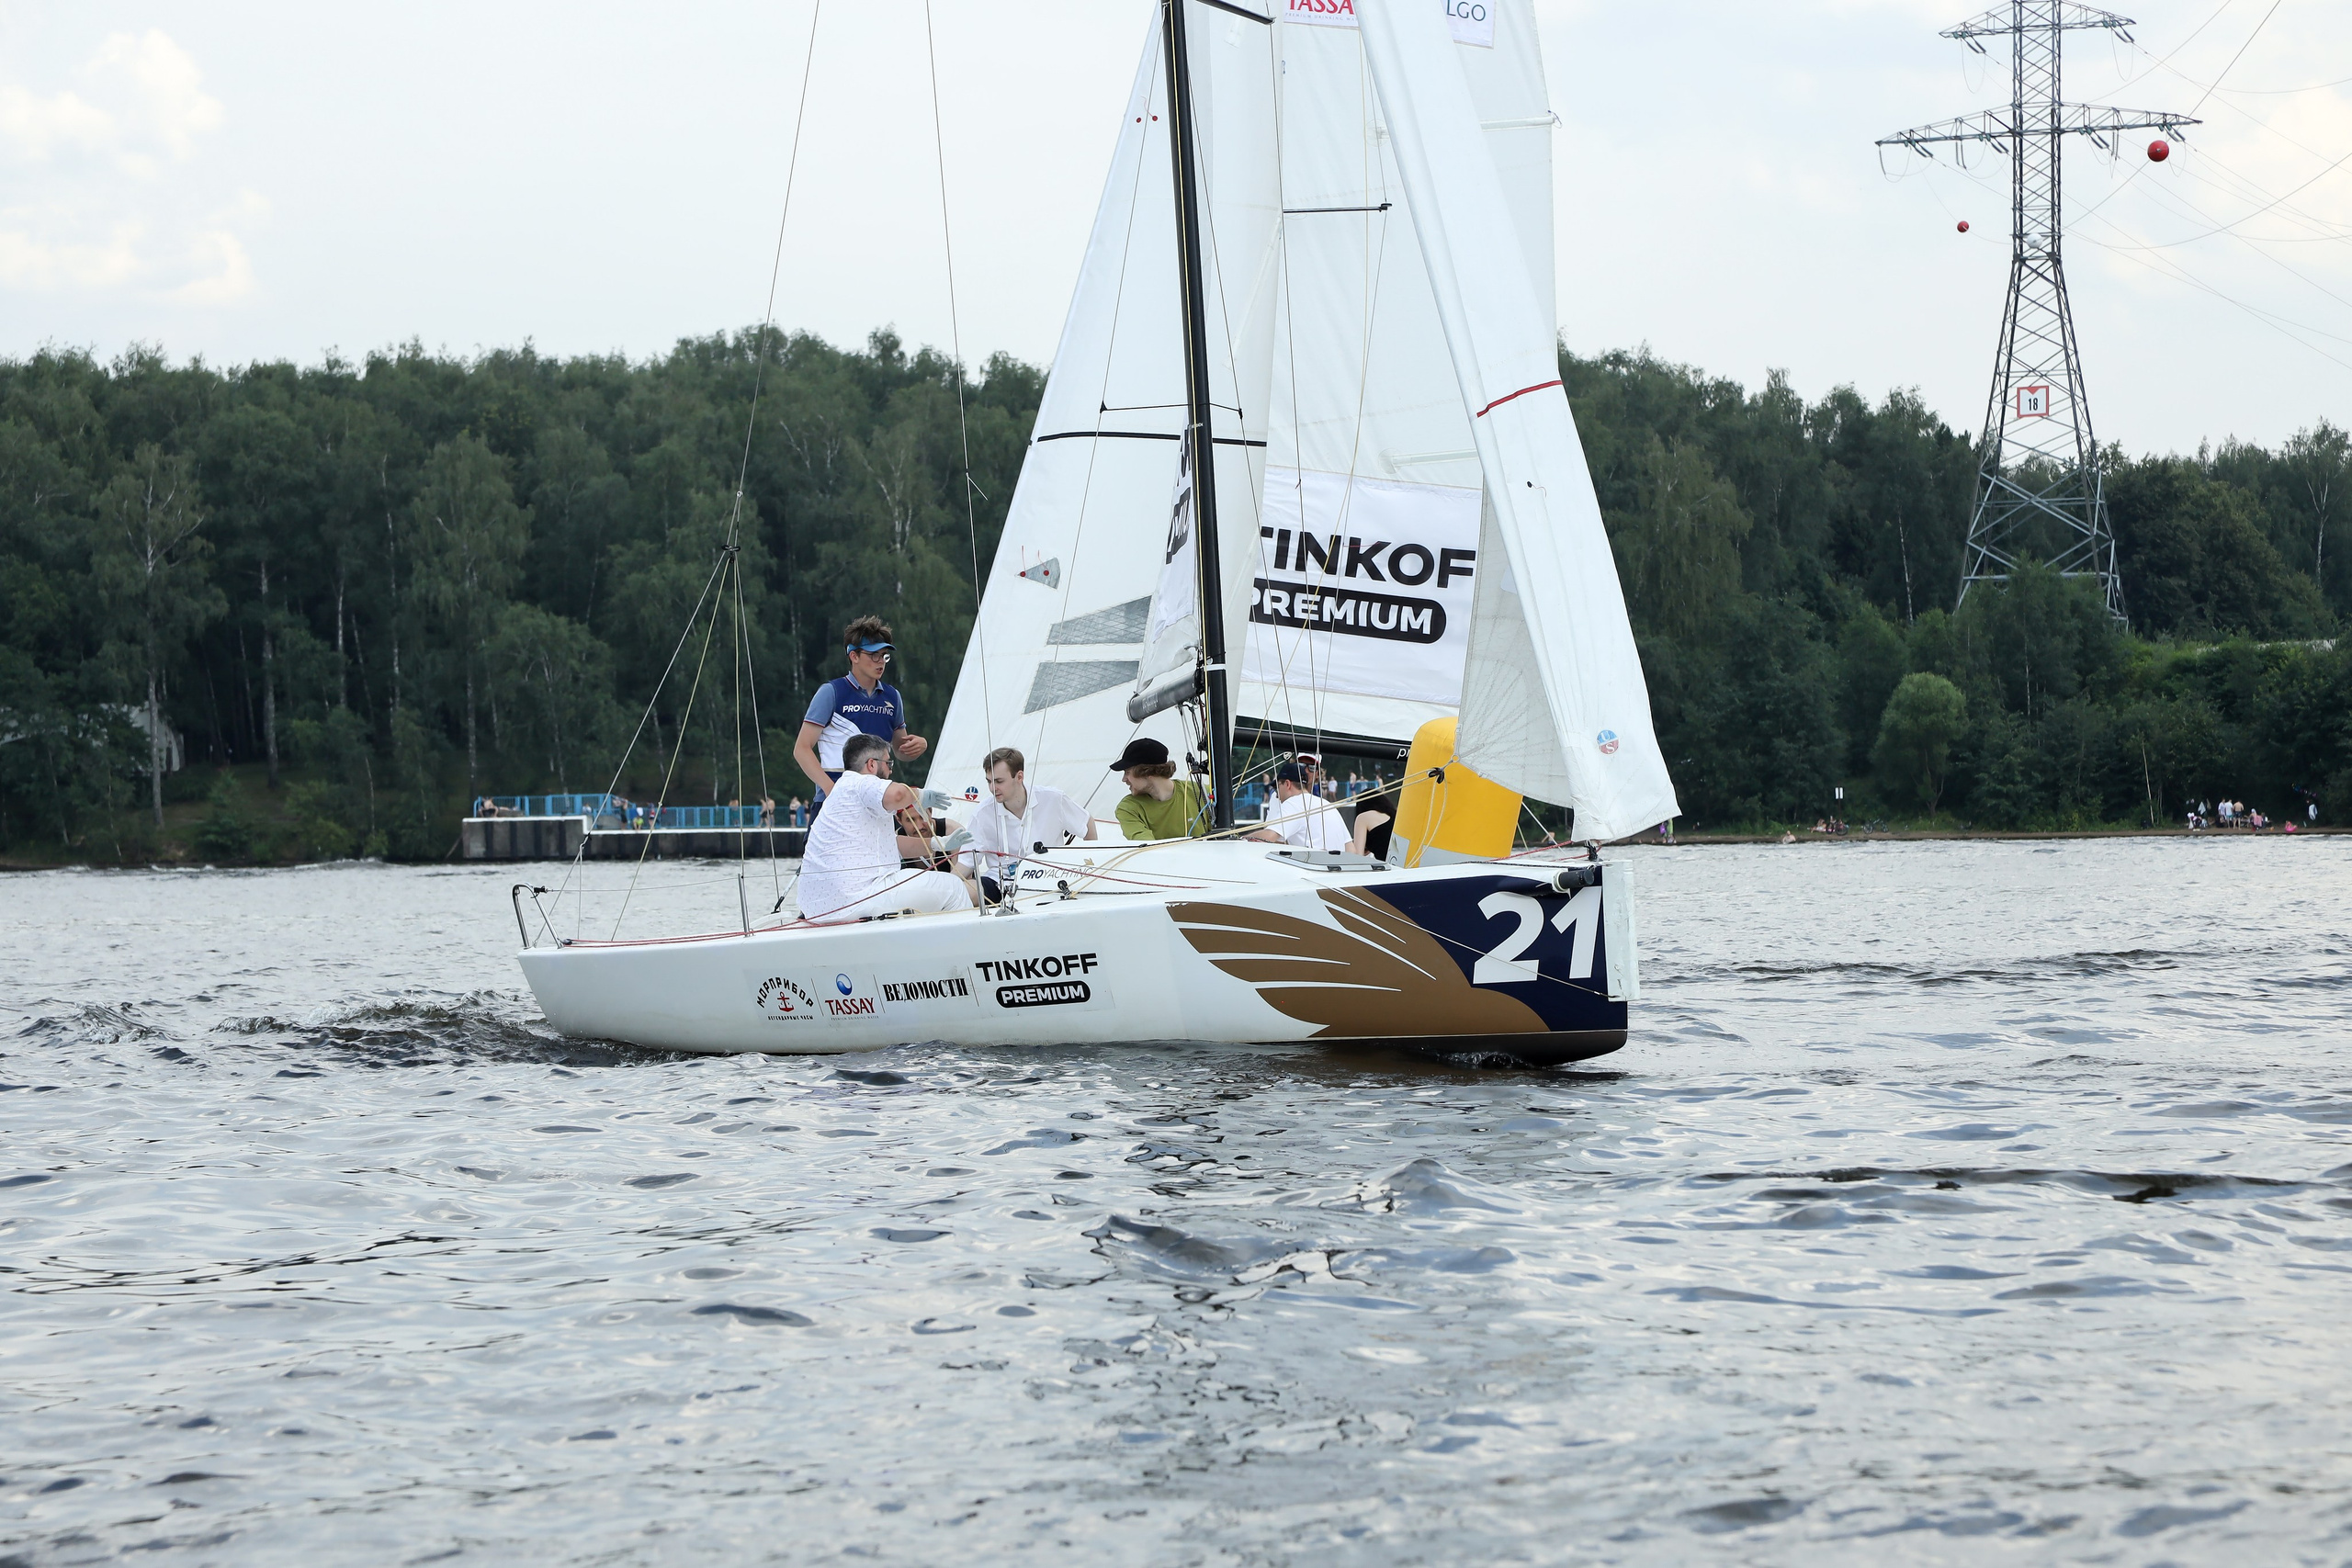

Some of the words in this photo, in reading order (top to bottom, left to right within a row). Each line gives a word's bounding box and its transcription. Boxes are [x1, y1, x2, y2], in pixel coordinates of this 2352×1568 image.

[2028, 397, 2038, 411] 18
[842, 704, 894, 716] PROYACHTING
[1021, 867, 1093, 879] PROYACHTING
[1472, 886, 1602, 985] 21
[975, 953, 1099, 982] TINKOFF
[756, 977, 814, 1009] МОРПРИБОР
[882, 978, 969, 1002] ВЕДОМОСТИ
[1001, 985, 1086, 1004] PREMIUM
[825, 998, 876, 1015] TASSAY
